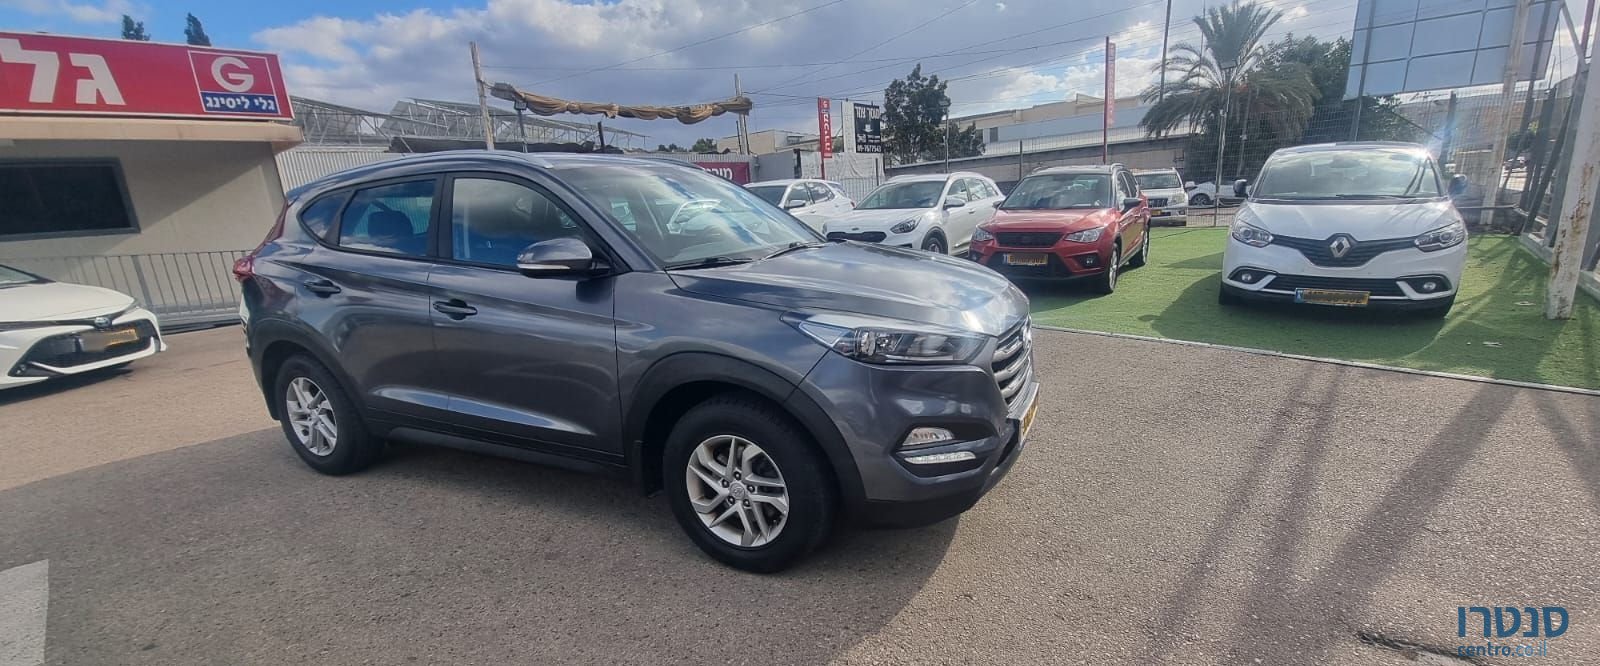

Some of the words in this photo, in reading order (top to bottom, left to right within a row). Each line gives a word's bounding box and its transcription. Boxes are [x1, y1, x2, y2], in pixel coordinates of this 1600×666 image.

[211, 56, 254, 93] G
[205, 95, 250, 109] ליסינג
[253, 96, 276, 111] גלי
